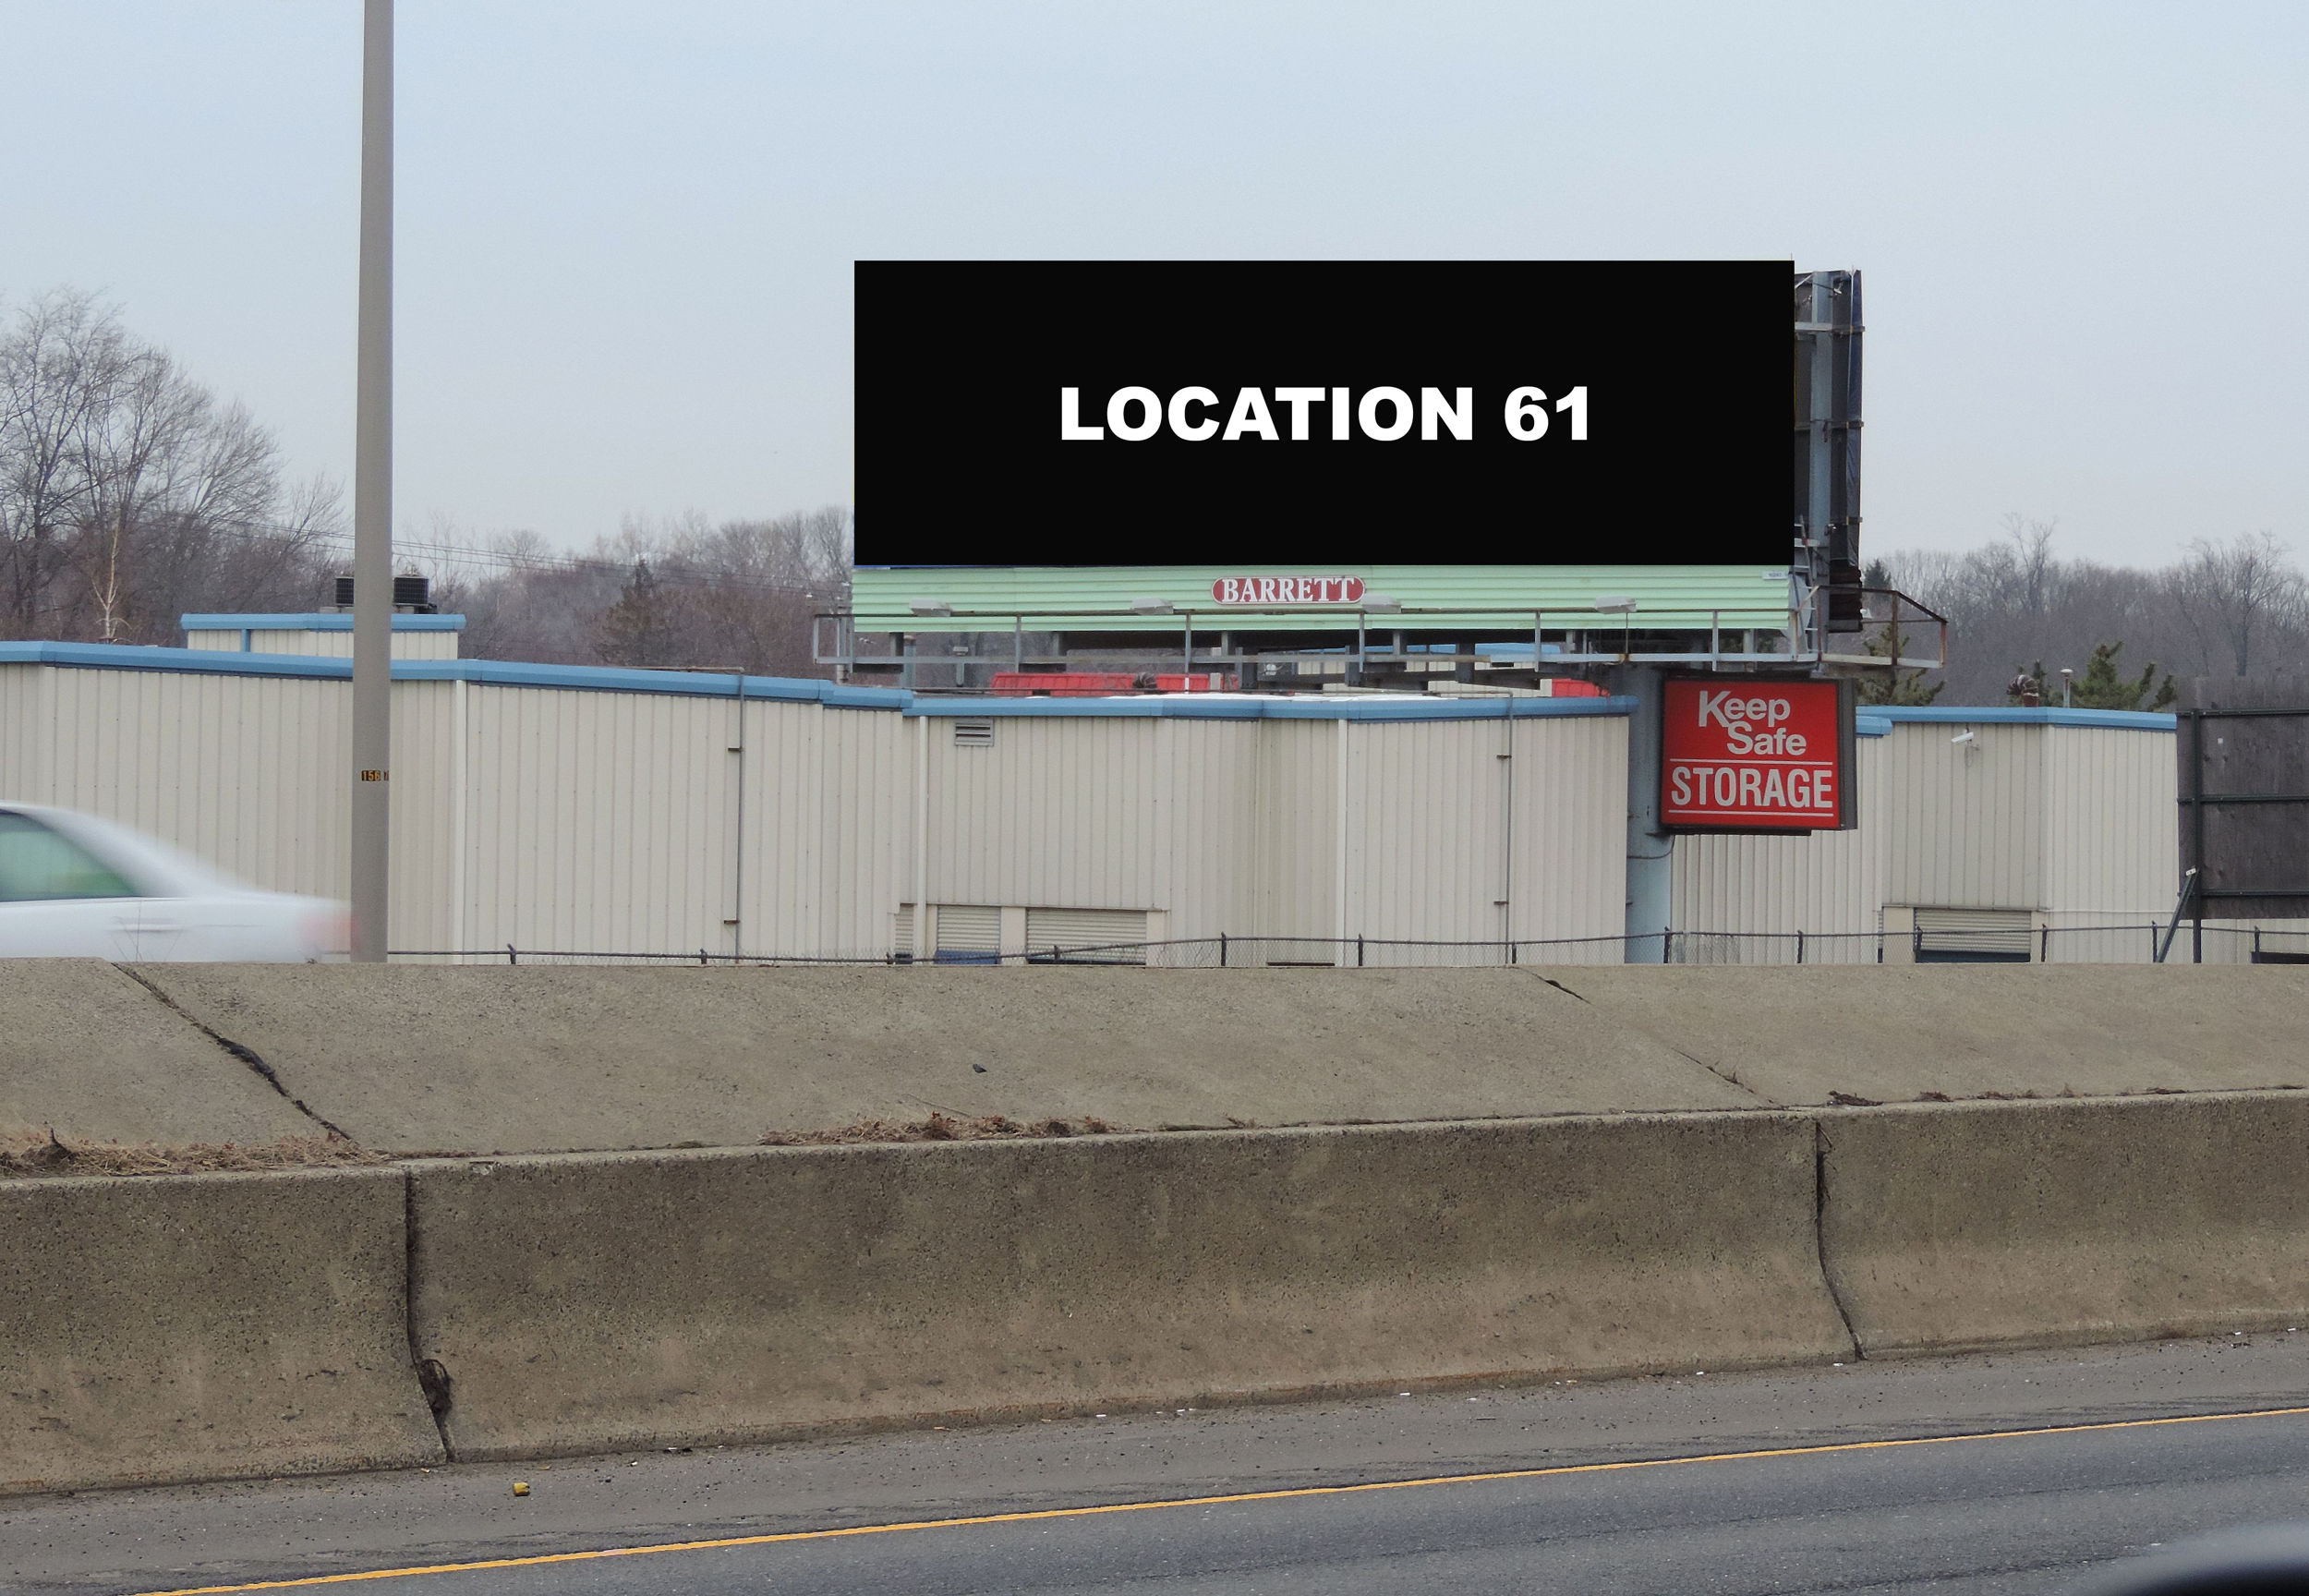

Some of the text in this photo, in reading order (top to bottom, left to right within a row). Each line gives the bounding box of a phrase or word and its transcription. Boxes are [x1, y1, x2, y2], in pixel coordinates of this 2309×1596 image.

[1222, 577, 1355, 602] BARRETT
[1698, 690, 1791, 728] Keep
[1726, 720, 1807, 756] Safe
[1671, 766, 1833, 808] STORAGE
